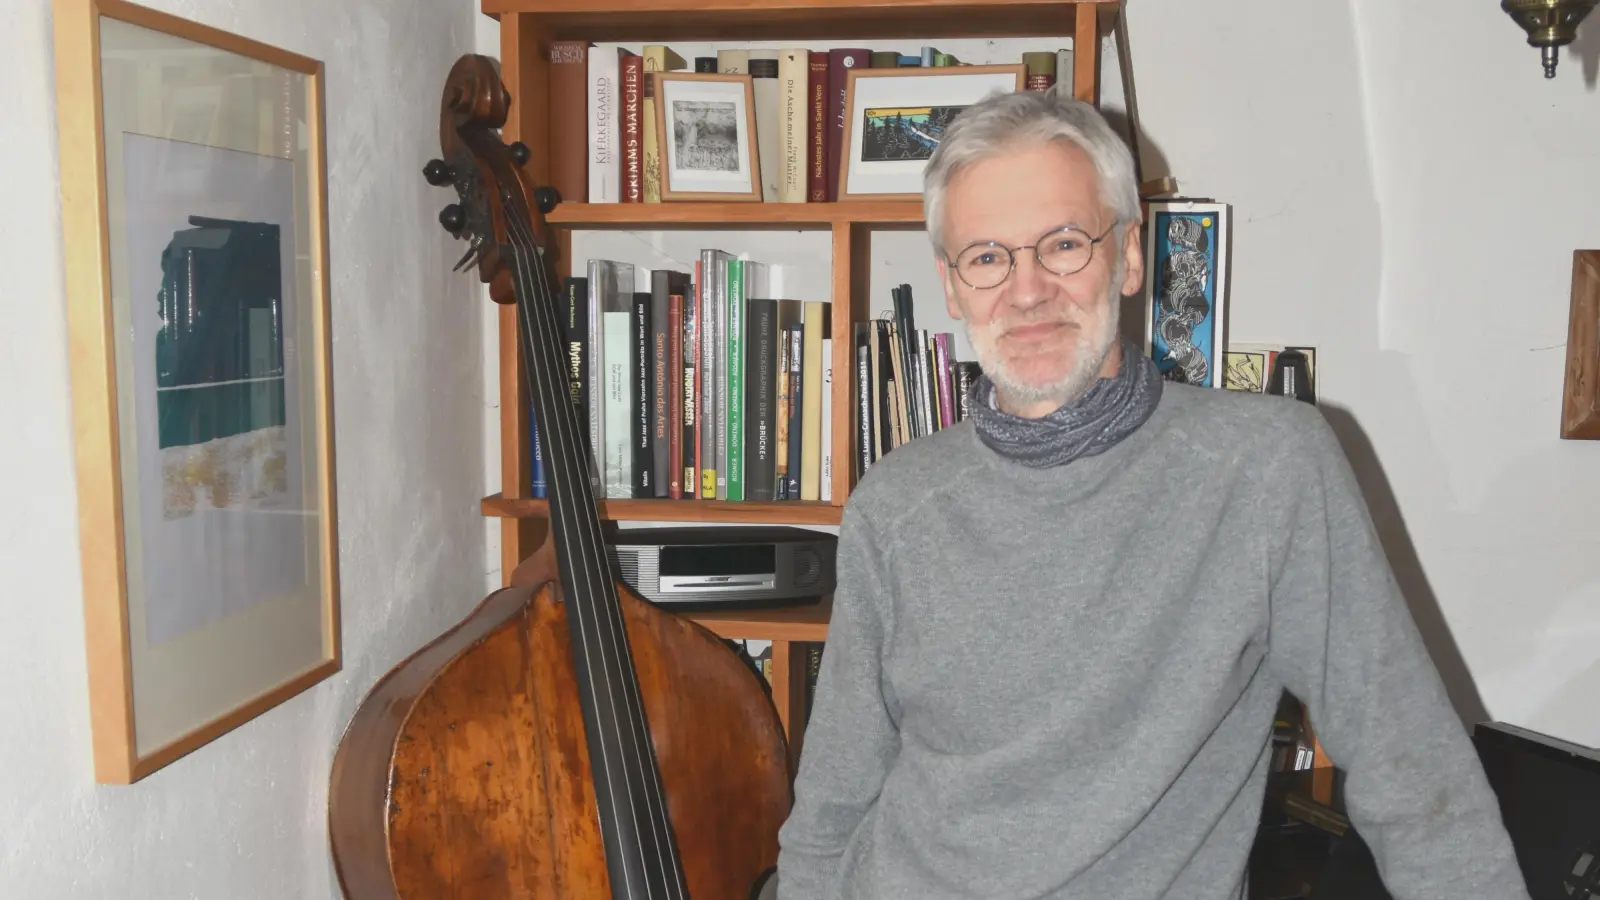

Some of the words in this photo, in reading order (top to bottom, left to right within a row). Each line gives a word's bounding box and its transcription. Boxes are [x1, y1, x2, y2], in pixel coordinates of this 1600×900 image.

[626, 65, 637, 134] MÄRCHEN
[596, 77, 606, 165] KIERKEGAARD
[628, 139, 638, 199] GRIMMS
[569, 341, 581, 378] Mythos
[656, 332, 665, 358] Santo
[656, 360, 665, 396] António
[656, 397, 665, 413] das
[656, 414, 665, 439] Artes
